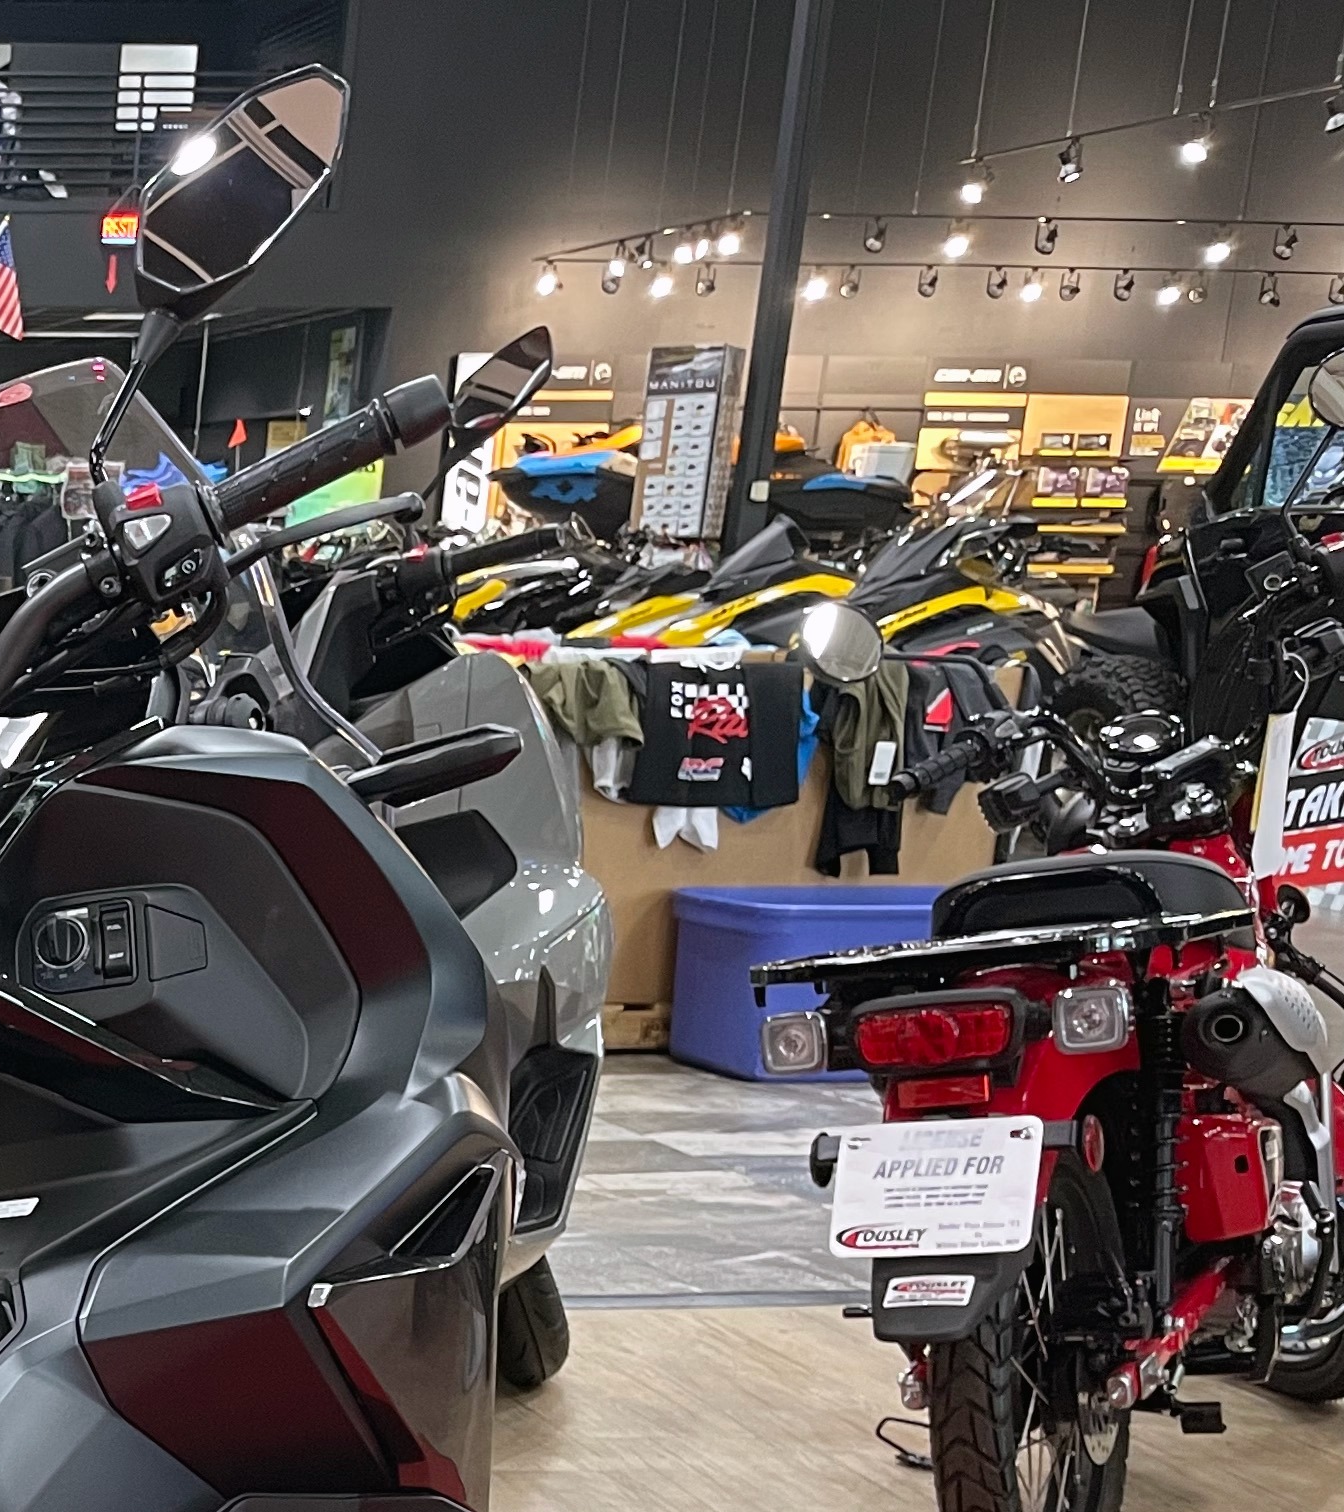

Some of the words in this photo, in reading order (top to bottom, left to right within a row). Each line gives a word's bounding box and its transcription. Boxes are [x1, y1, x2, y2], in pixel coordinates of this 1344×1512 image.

[649, 377, 716, 390] MANITOU
[1284, 780, 1344, 828] TAK
[873, 1157, 958, 1180] APPLIED
[962, 1155, 1005, 1176] FOR
